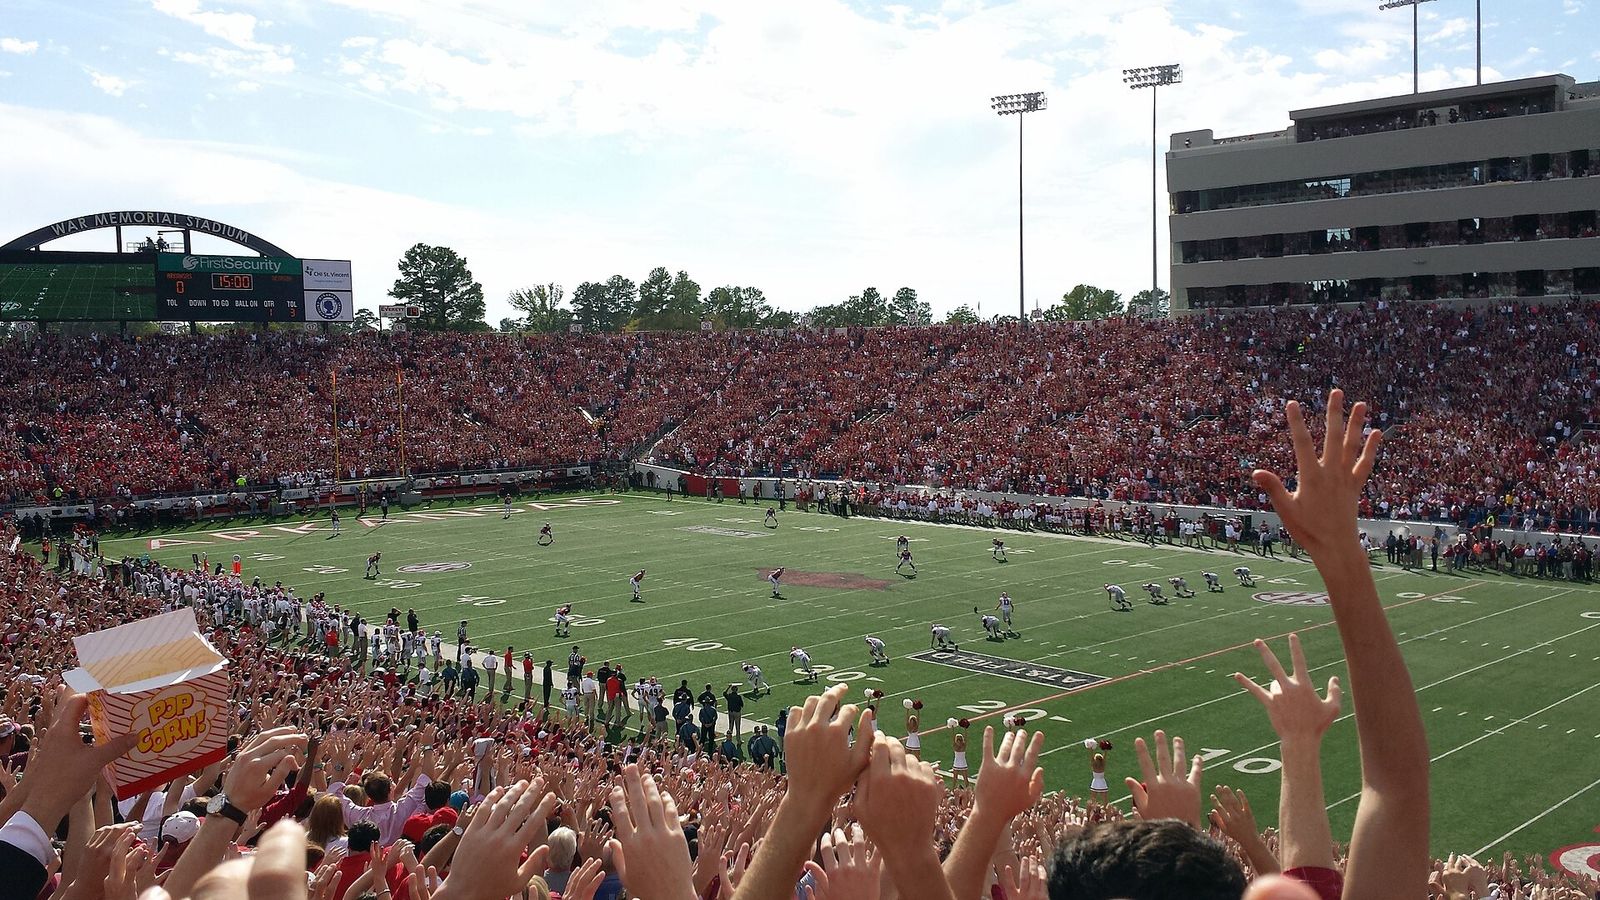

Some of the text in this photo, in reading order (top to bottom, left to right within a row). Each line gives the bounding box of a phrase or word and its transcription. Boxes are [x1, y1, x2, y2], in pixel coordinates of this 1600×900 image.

[51, 212, 249, 243] WAR MEMORIAL STADIUM
[200, 256, 281, 273] FirstSecurity
[176, 280, 185, 294] 0
[219, 275, 250, 289] 15:00
[189, 299, 207, 307] DOWN
[212, 299, 220, 307] TO
[263, 300, 275, 308] QTR
[290, 308, 296, 317] 3
[147, 496, 620, 551] ARKANSAS
[662, 637, 724, 652] 40
[793, 664, 867, 682] 30
[931, 651, 1087, 685] AT&T FIELD
[563, 692, 574, 700] 32
[648, 688, 658, 697] 49
[148, 693, 193, 726] POP
[956, 700, 1048, 722] 20
[136, 709, 206, 753] CORN!
[1190, 747, 1283, 774] 10
